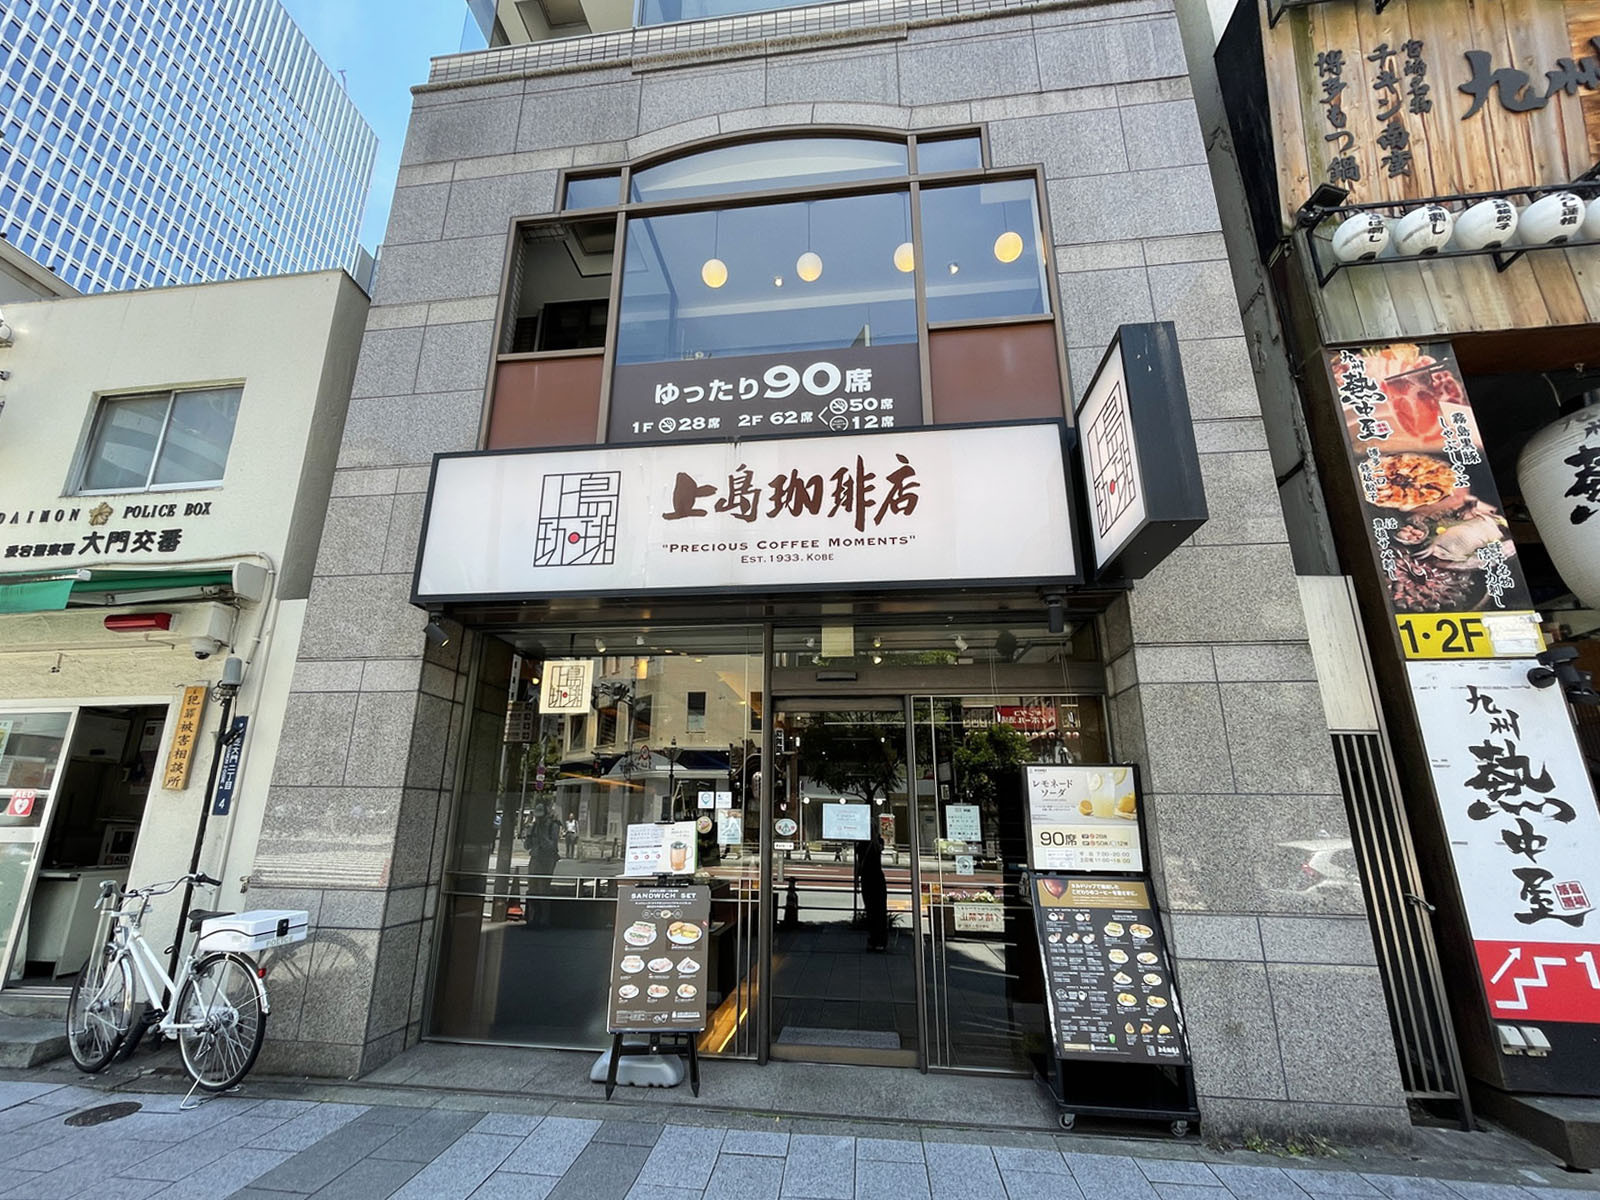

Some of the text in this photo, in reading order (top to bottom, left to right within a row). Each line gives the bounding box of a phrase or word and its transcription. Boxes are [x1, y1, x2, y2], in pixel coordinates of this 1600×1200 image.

[1401, 39, 1432, 114] 宮崎名物
[1315, 50, 1361, 184] 博多もつ鍋
[1368, 43, 1413, 179] チキン南蛮
[654, 361, 873, 406] ゆったり90席
[849, 397, 894, 412] 50席
[631, 411, 814, 433] 1F 28席 2F 62席
[852, 415, 894, 429] 12席
[661, 453, 921, 532] 上島珈琲店
[123, 503, 177, 519] POLICE
[183, 501, 213, 516] BOX
[4, 528, 183, 558] 愛宕警察署 大門交番
[756, 538, 820, 550] COFFEE
[165, 694, 201, 789] 犯罪被害相談所
[1033, 779, 1073, 789] レモネード
[1041, 788, 1067, 798] ソーダ
[219, 798, 226, 809] 4
[1464, 685, 1597, 928] 九州熱中屋
[1040, 831, 1077, 847] 90席
